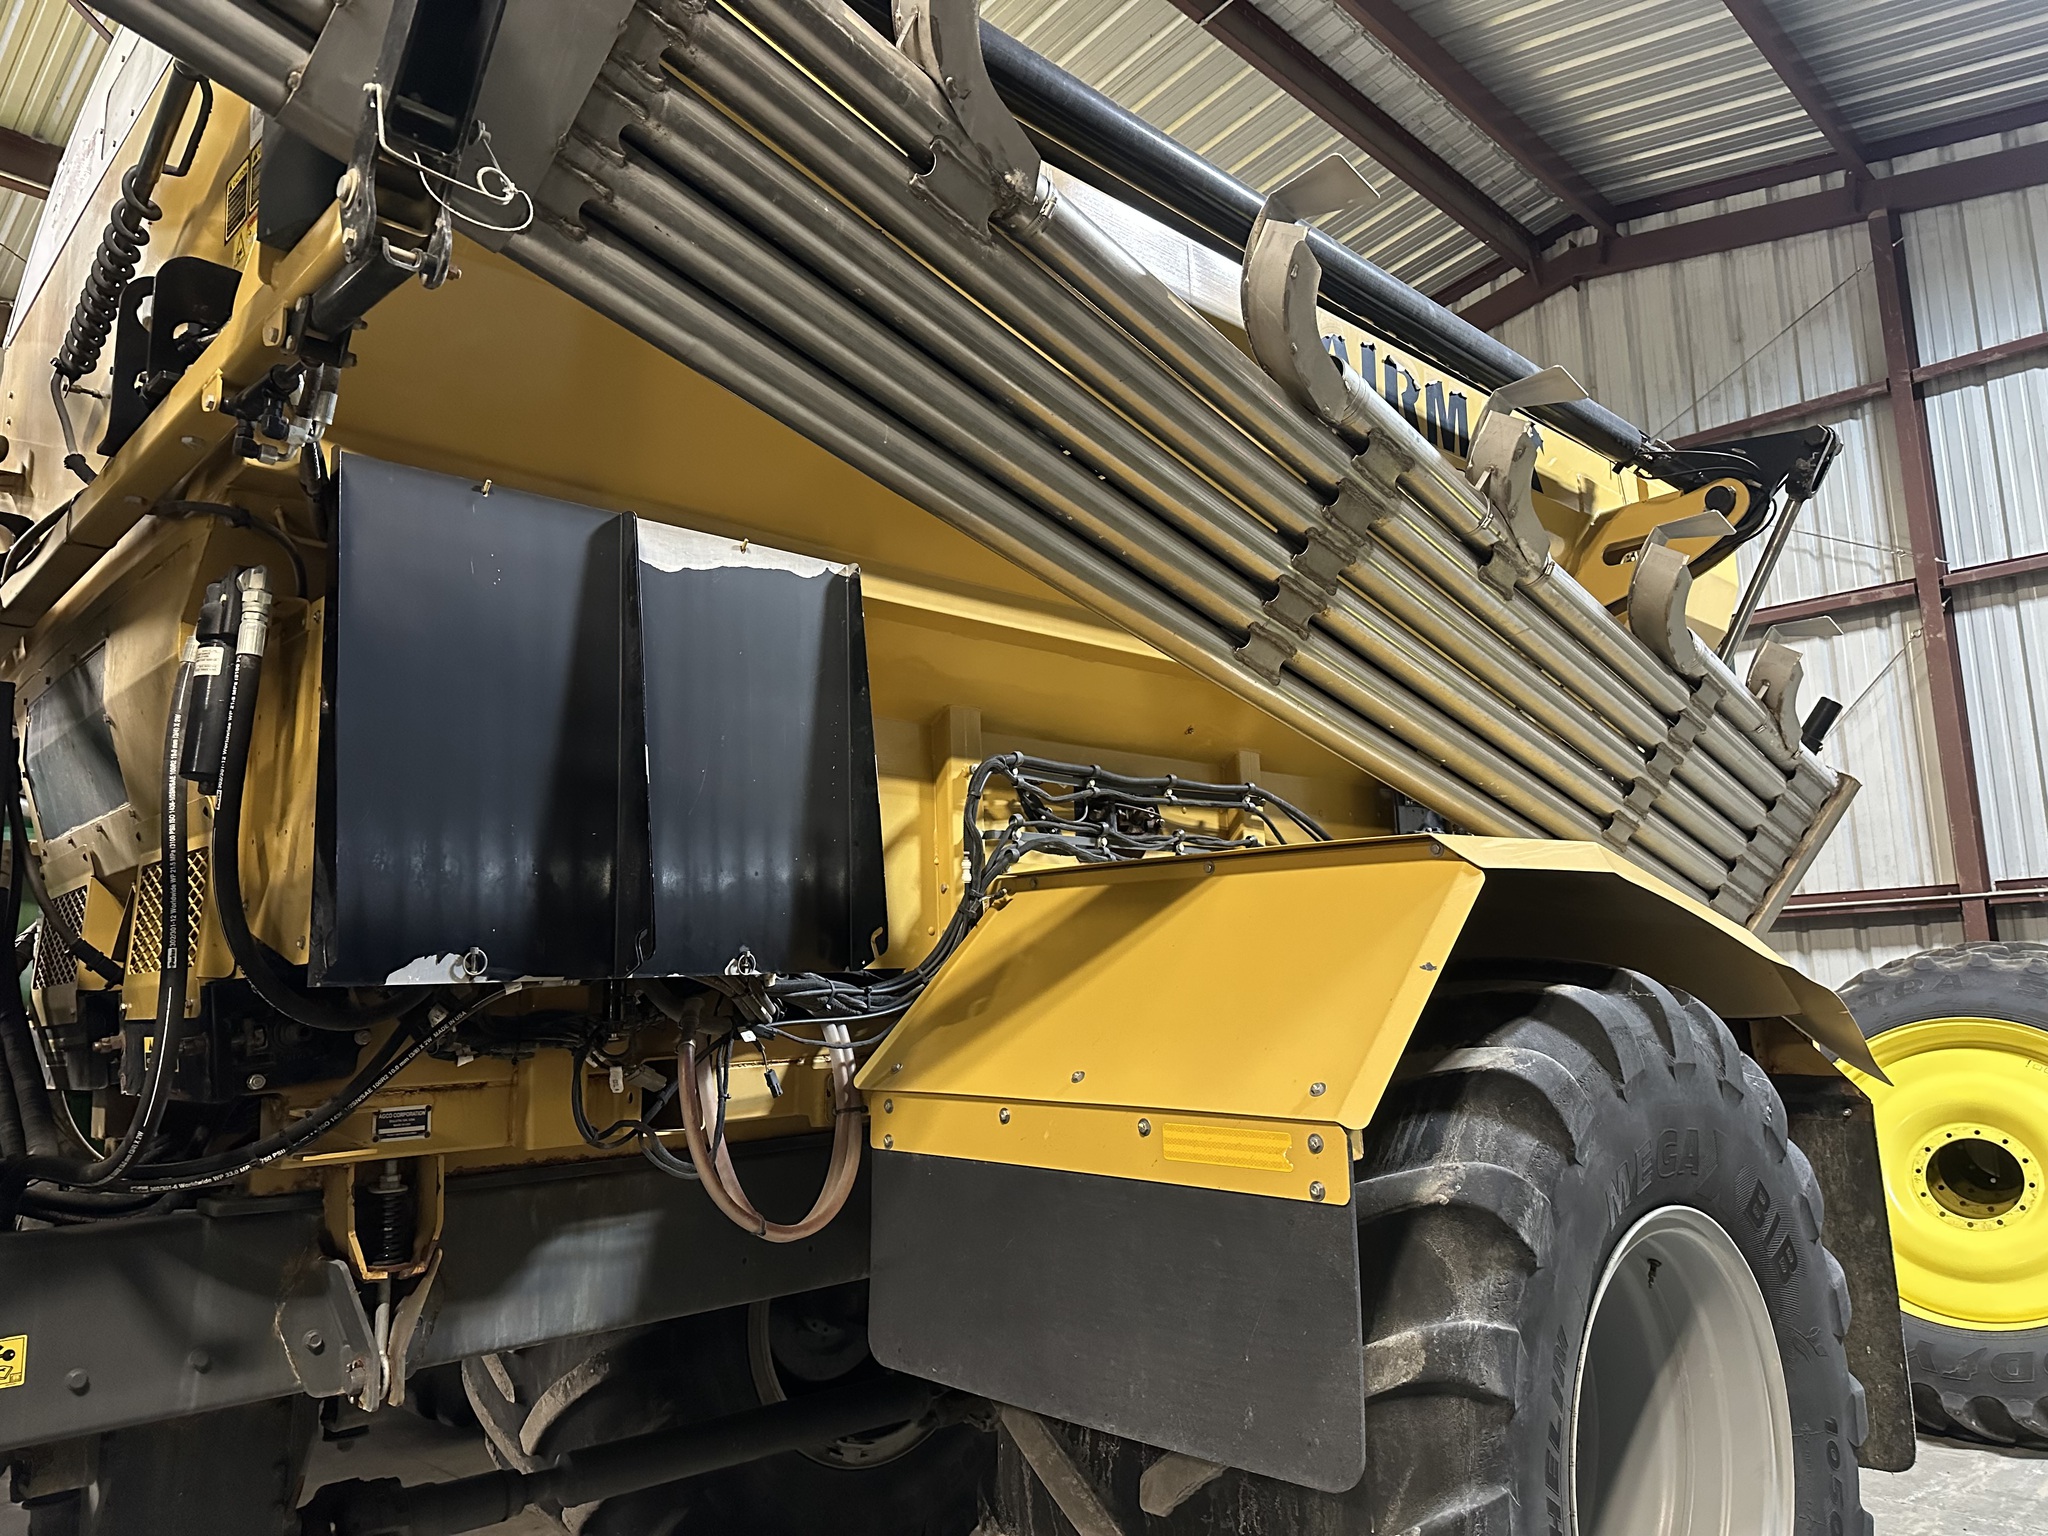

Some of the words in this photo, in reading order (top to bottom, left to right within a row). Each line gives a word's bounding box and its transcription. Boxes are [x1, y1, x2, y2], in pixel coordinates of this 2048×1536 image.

[223, 722, 231, 755] Worldwide
[228, 710, 233, 721] WP
[170, 874, 176, 883] WP
[179, 1179, 212, 1188] Worldwide
[225, 1169, 239, 1177] 33.0
[318, 1121, 330, 1130] ISO
[373, 1074, 389, 1089] 100R2
[399, 1057, 409, 1067] mm
[424, 1037, 432, 1046] 2W
[433, 1024, 449, 1037] MADE
[454, 1011, 467, 1021] USA
[378, 1112, 393, 1120] AGCO
[393, 1110, 426, 1118] CORPORATION
[1604, 1127, 1699, 1232] MEGA
[1745, 1179, 1799, 1286] BIB
